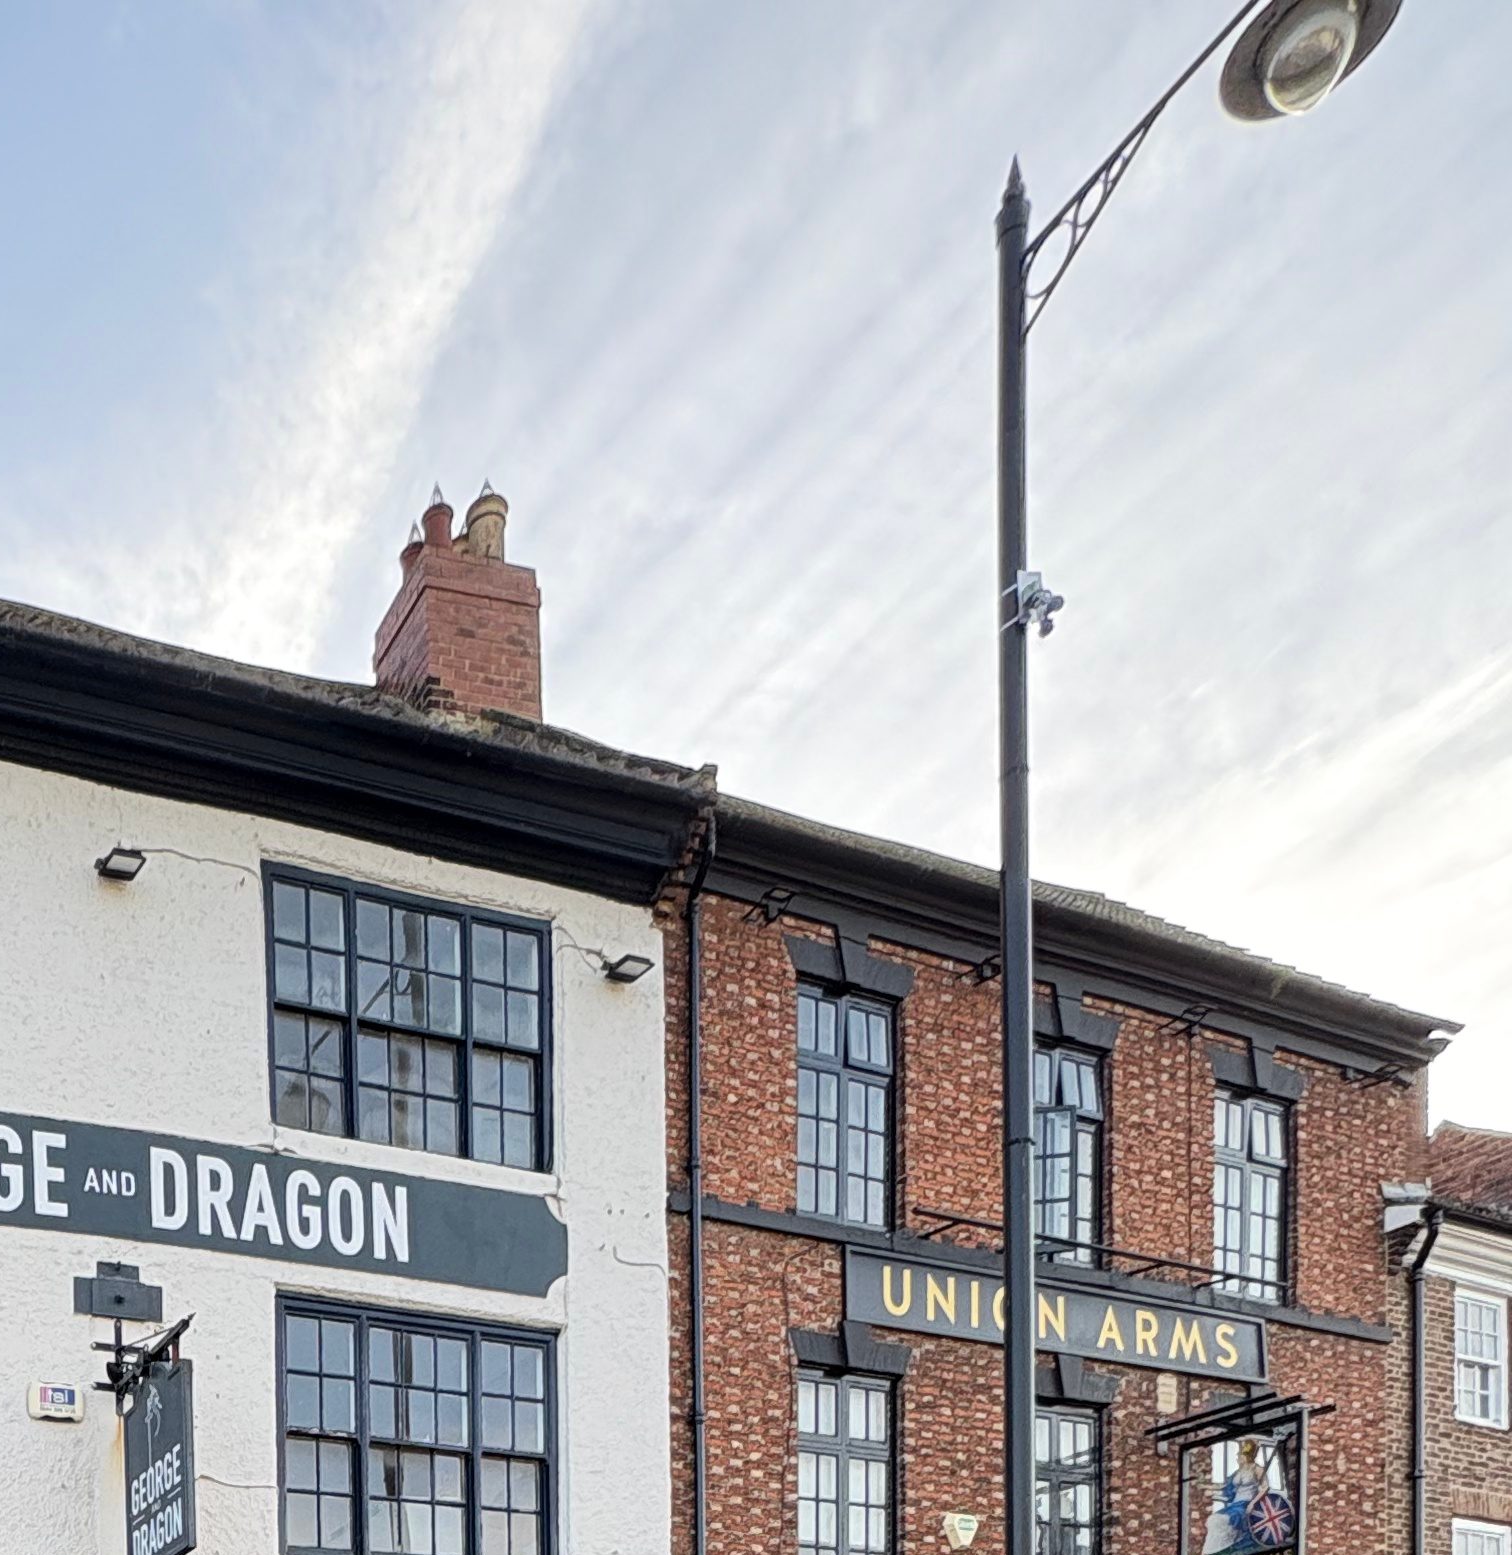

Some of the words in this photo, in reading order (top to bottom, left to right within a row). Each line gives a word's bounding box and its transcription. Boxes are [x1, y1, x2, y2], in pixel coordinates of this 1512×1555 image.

[83, 1167, 136, 1197] AND
[149, 1145, 410, 1264] DRAGON
[1096, 1305, 1239, 1369] ARMS
[131, 1443, 182, 1516] GEORGE
